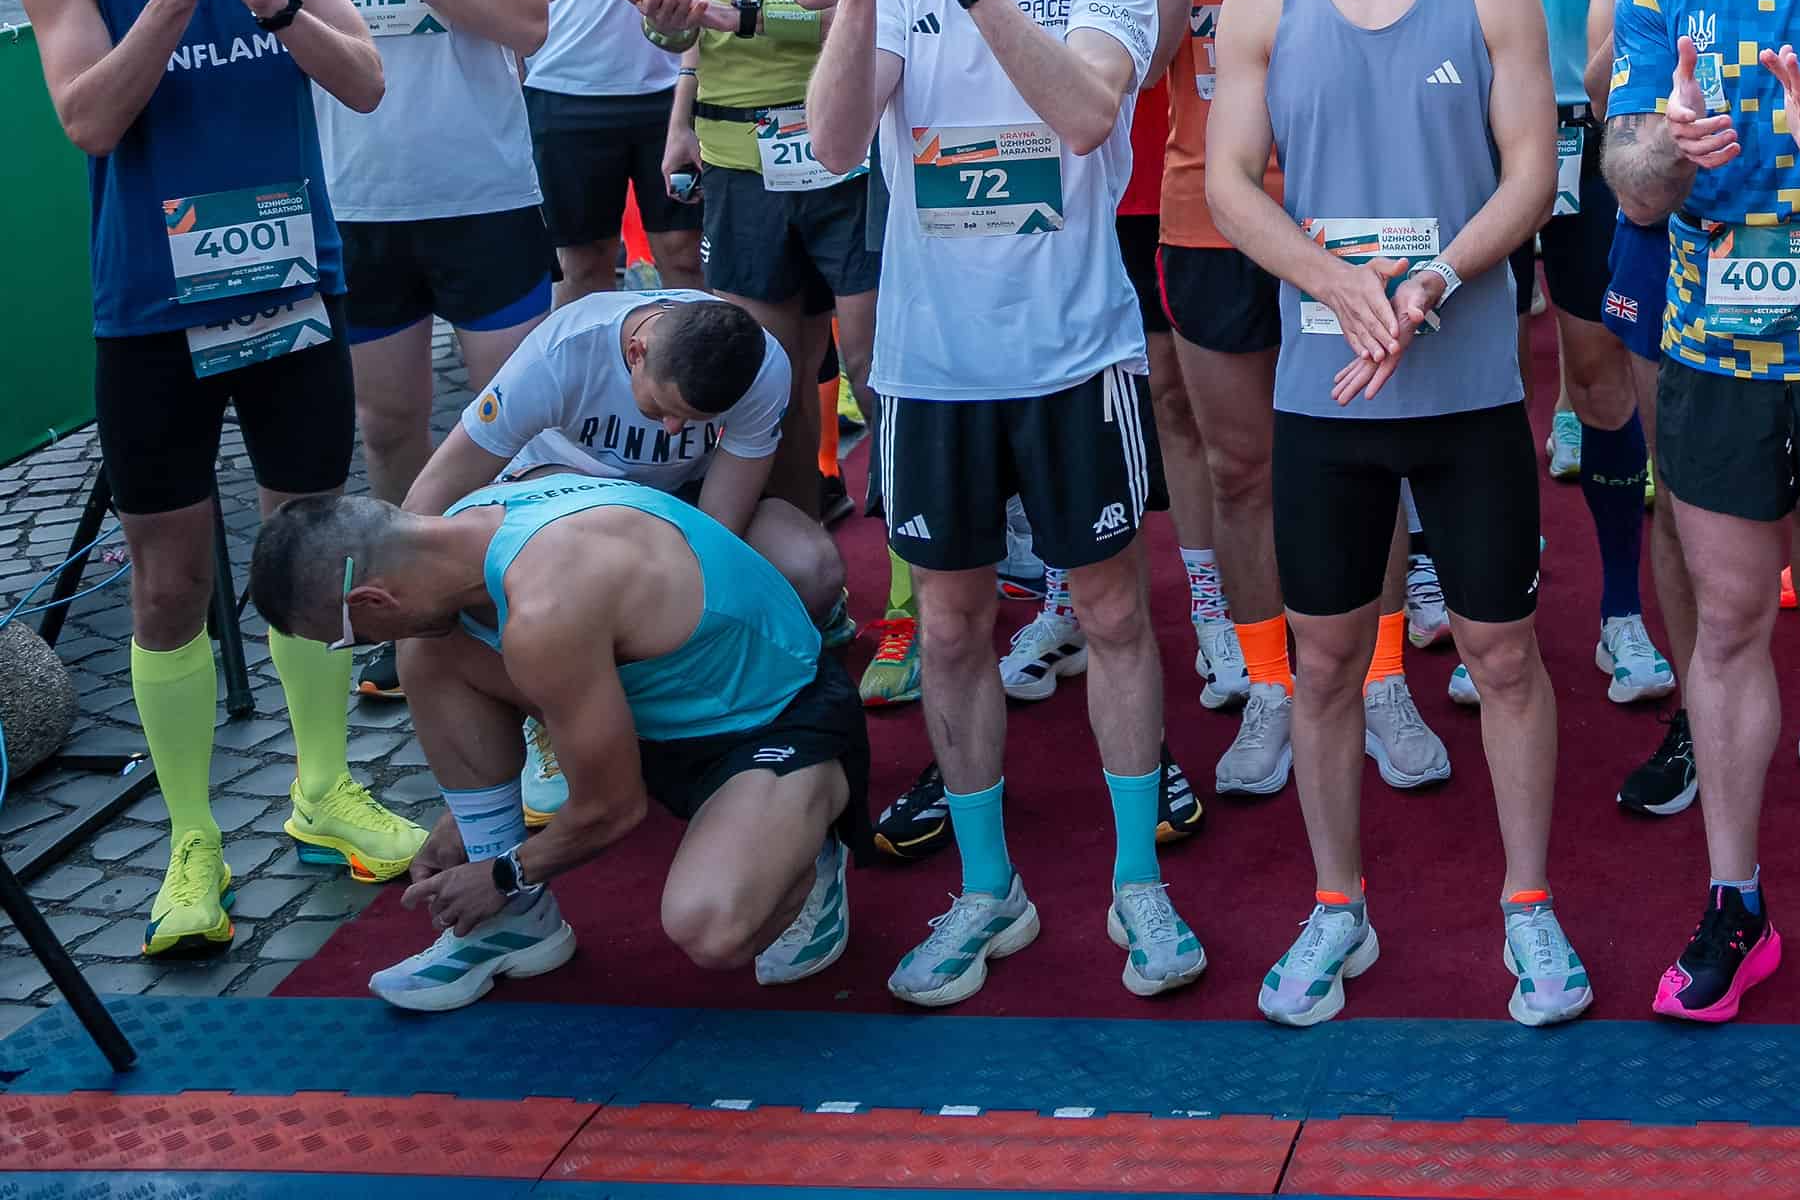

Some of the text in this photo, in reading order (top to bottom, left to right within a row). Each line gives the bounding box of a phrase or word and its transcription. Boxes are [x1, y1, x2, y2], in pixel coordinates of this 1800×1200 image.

[167, 32, 290, 72] NFLAM
[999, 138, 1052, 148] UZHHOROD
[1000, 146, 1052, 156] MARATHON
[959, 168, 1010, 200] 72
[259, 204, 304, 217] MARATHON
[194, 220, 290, 259] 4001
[1382, 234, 1432, 243] UZHHOROD
[1382, 242, 1432, 251] MARATHON
